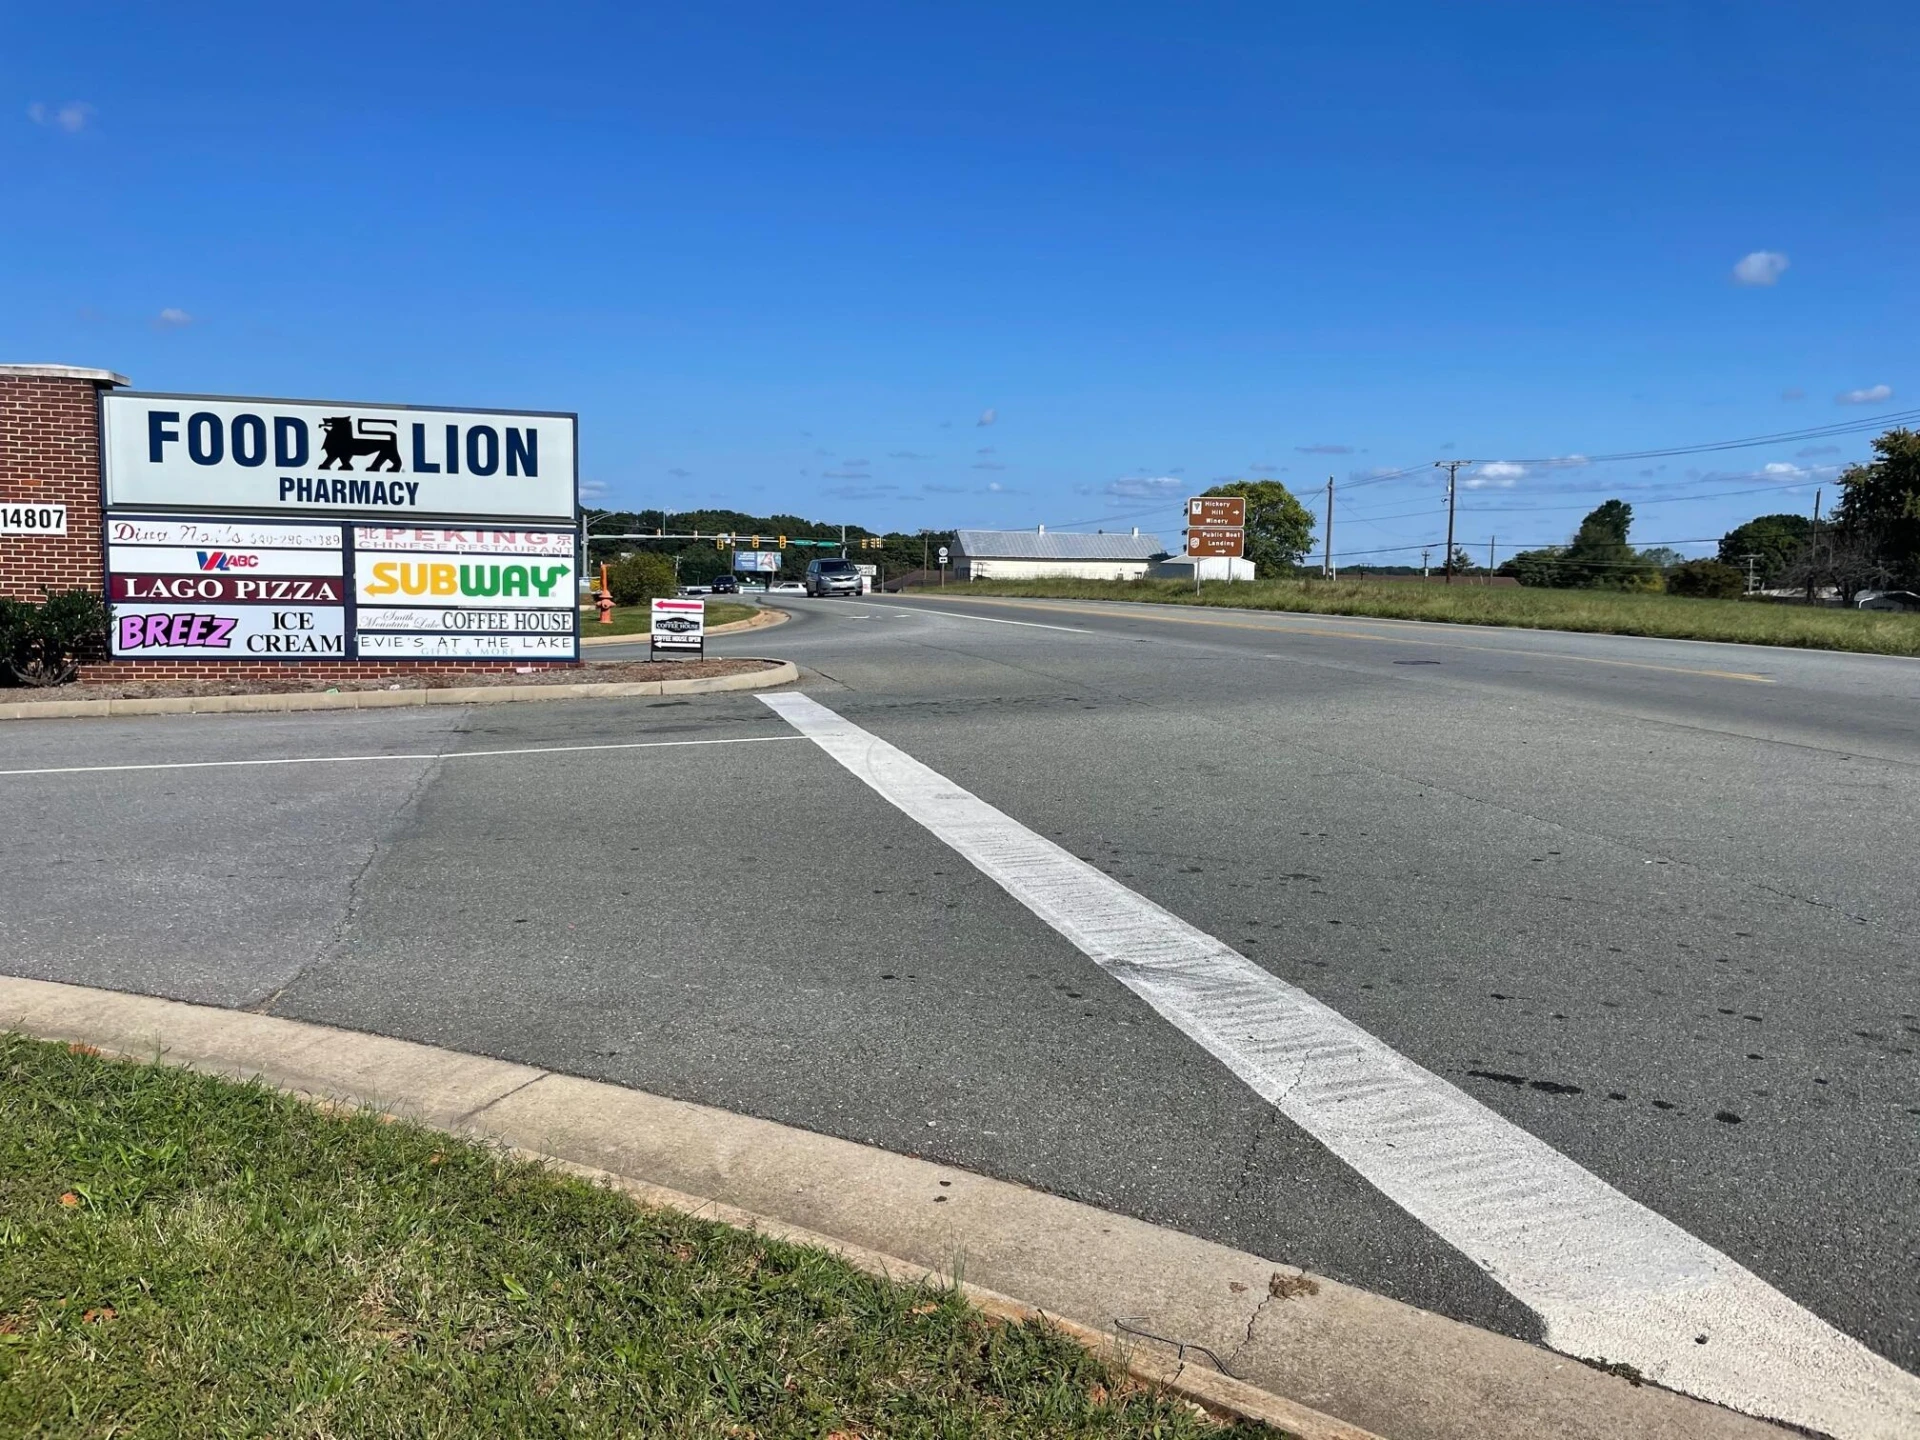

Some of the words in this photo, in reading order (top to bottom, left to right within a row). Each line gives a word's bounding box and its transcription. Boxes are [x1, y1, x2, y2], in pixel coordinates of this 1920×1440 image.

[147, 410, 309, 467] FOOD
[412, 422, 539, 478] LION
[279, 477, 419, 506] PHARMACY
[1, 508, 64, 529] 14807
[385, 528, 549, 545] PEKING
[455, 544, 573, 553] RESTAURANT
[124, 578, 224, 599] LAGO
[235, 580, 338, 600] PIZZA
[364, 562, 571, 598] SUBWAY
[272, 611, 315, 631] ICE
[382, 610, 414, 621] Smith
[442, 611, 510, 630] COFFEE
[514, 613, 572, 631] HOUSE
[119, 613, 239, 650] BREEZ
[246, 634, 343, 652] CREAM
[361, 636, 424, 648] EVIE'S
[438, 636, 462, 648] AT
[474, 637, 511, 648] THE
[523, 637, 573, 648] LAKE
[421, 647, 459, 656] GIFTS
[480, 647, 516, 656] MORE
